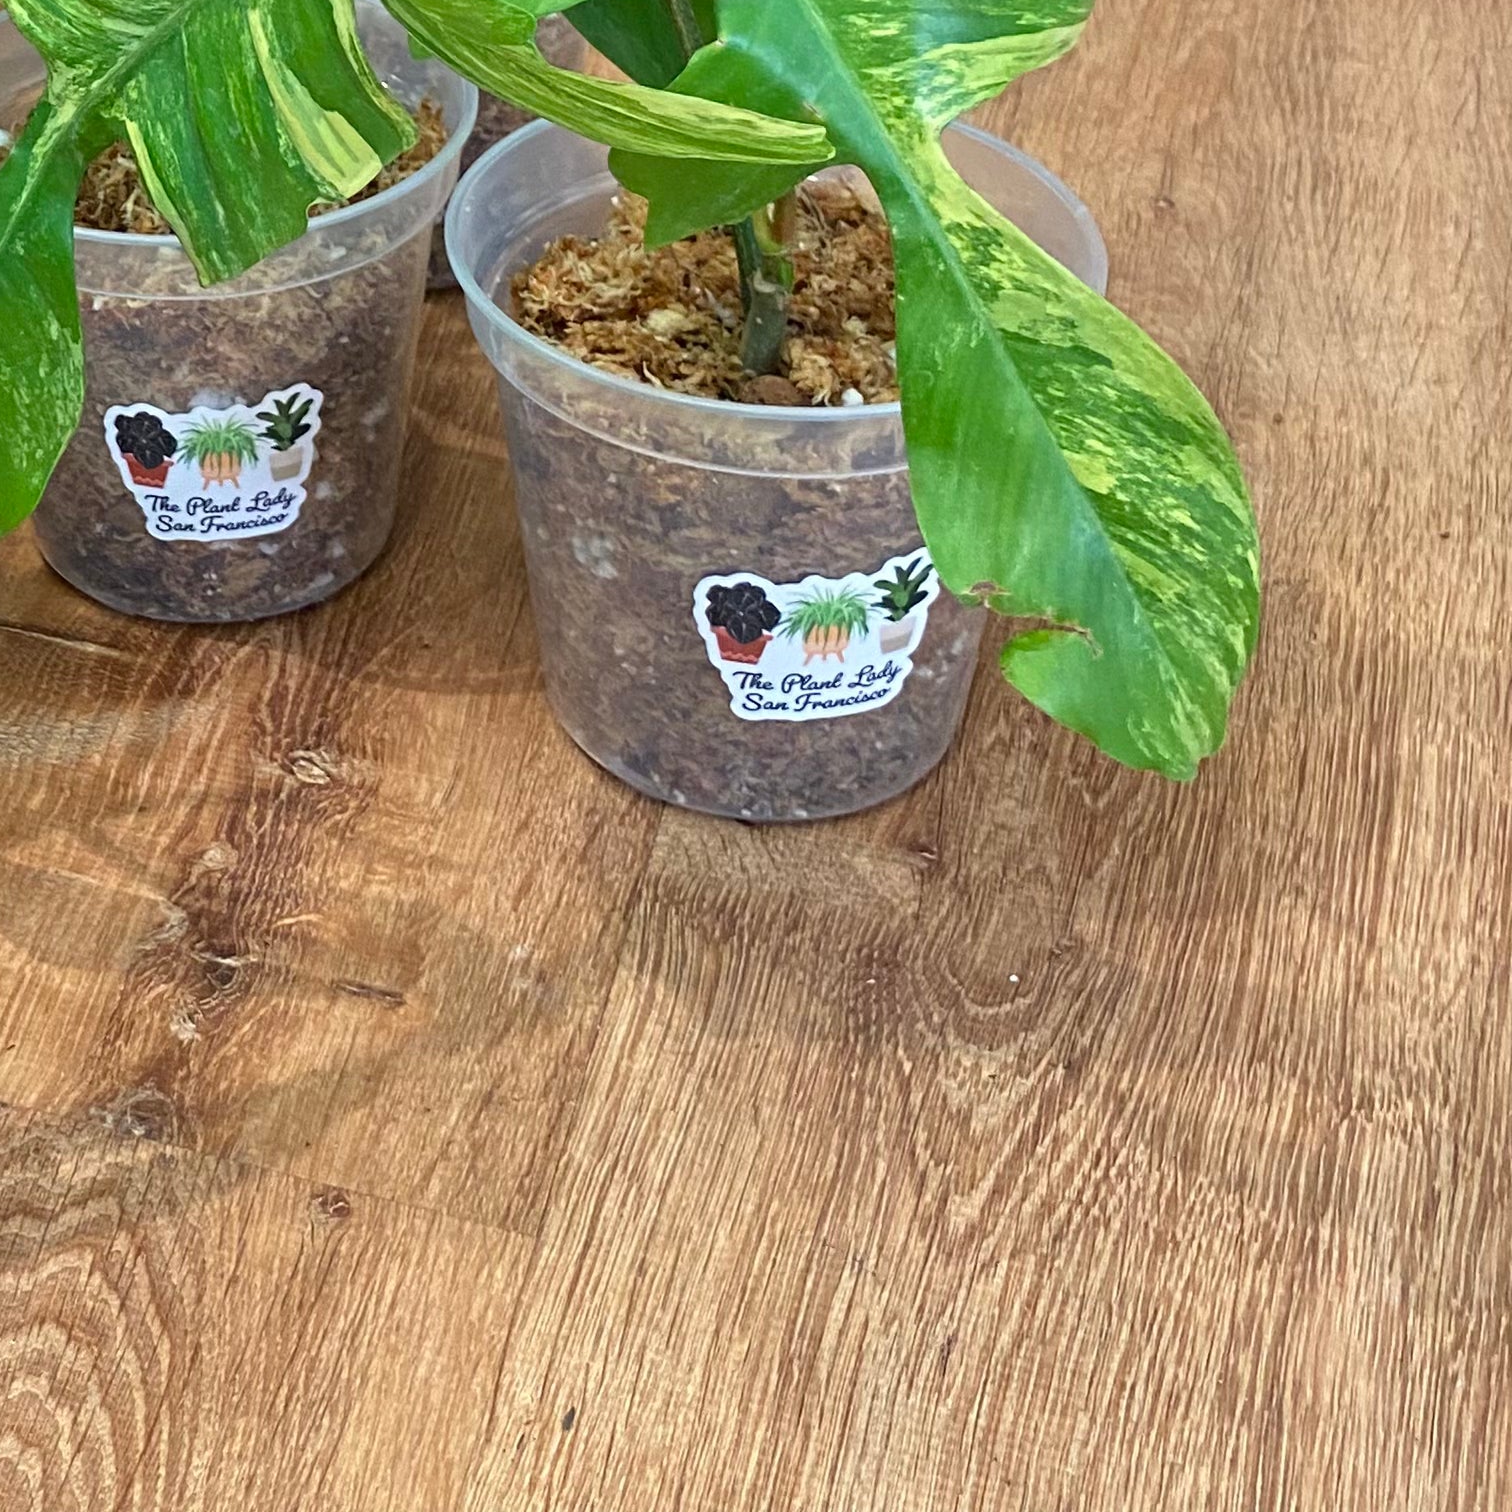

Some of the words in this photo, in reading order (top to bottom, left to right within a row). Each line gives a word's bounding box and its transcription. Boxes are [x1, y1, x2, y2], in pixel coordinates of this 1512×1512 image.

[144, 494, 180, 513] The
[187, 497, 240, 516] Plant
[246, 488, 296, 512] Lady
[155, 515, 195, 532] San
[201, 513, 288, 533] Francisco
[732, 670, 774, 691] The
[781, 672, 843, 694] Plant
[849, 660, 902, 688] Lady
[741, 693, 789, 712] San
[794, 688, 891, 712] Francisco
